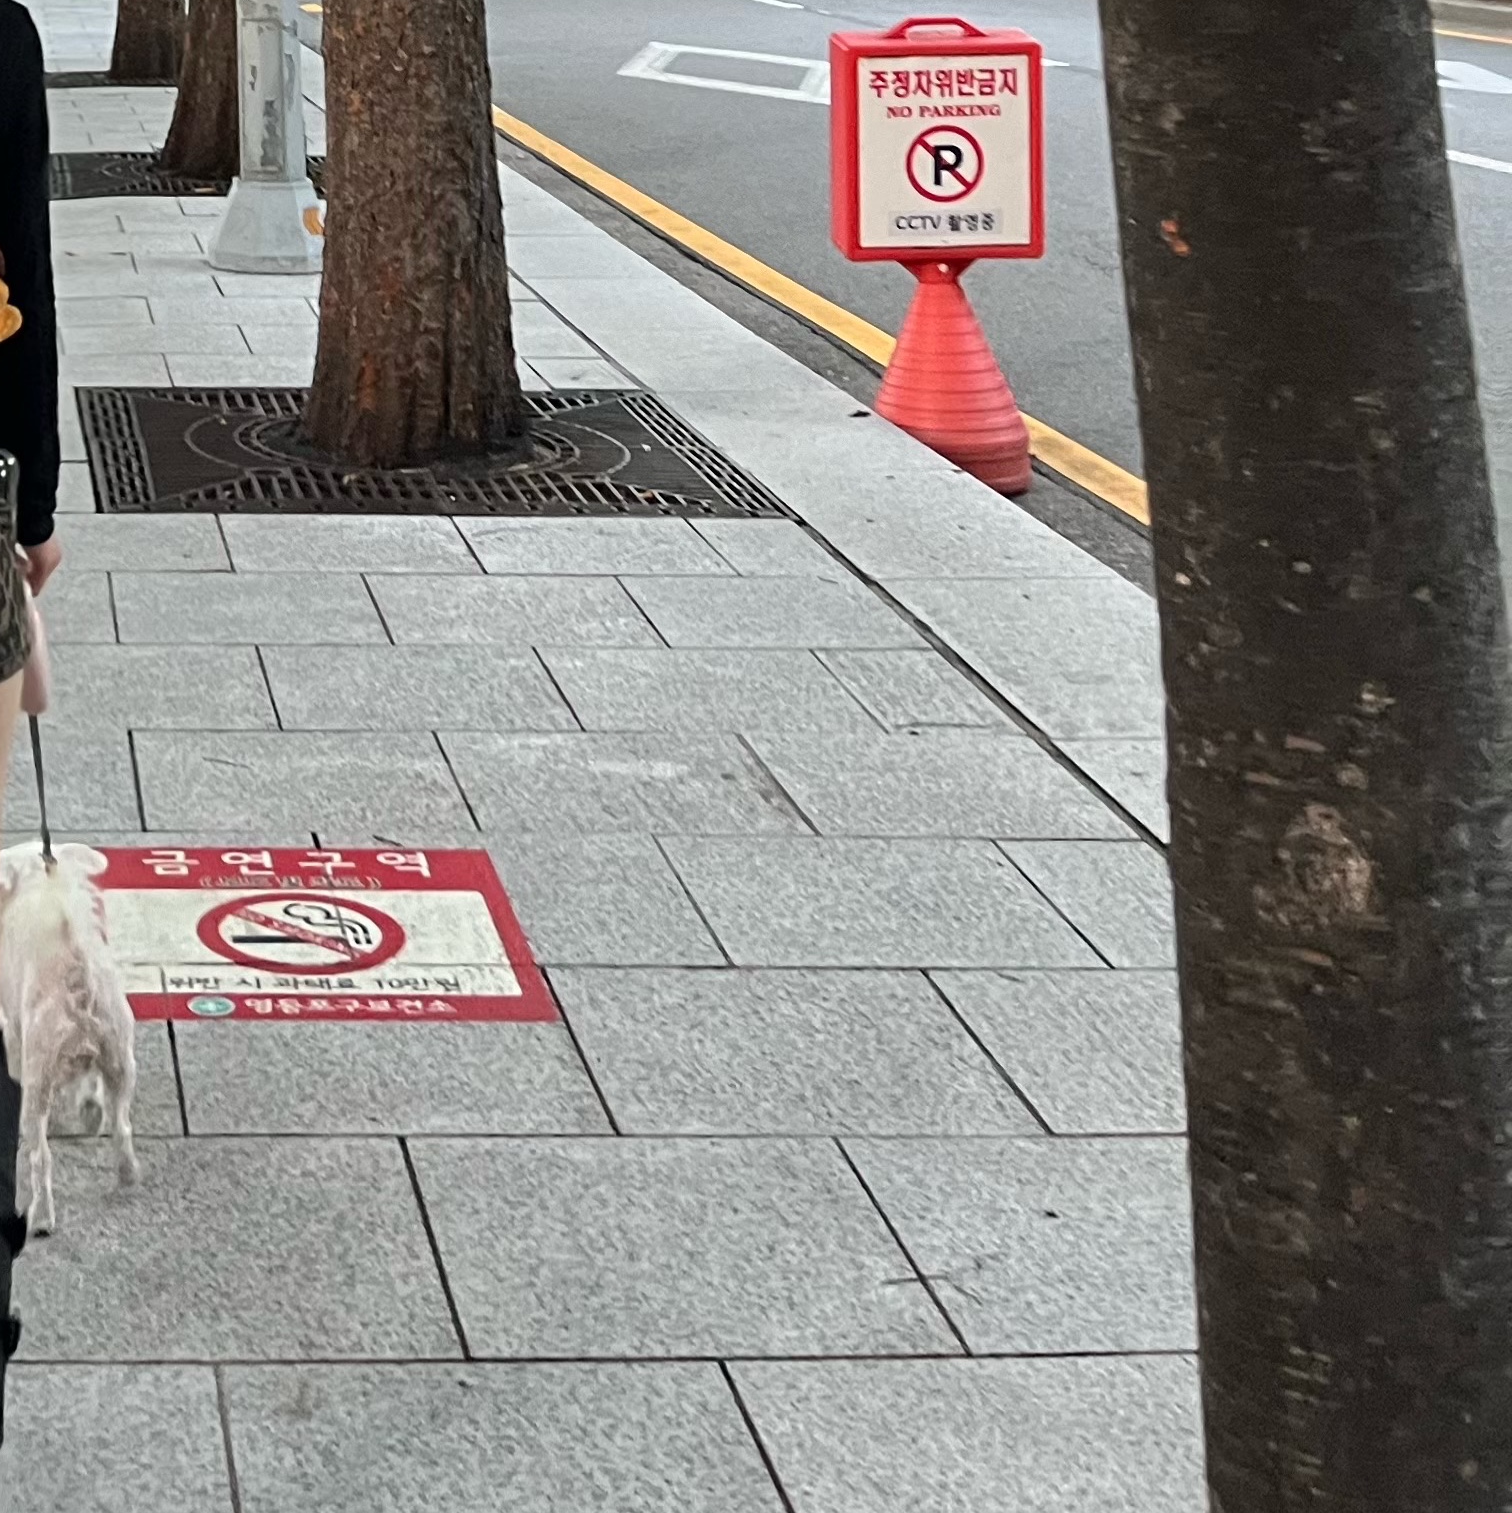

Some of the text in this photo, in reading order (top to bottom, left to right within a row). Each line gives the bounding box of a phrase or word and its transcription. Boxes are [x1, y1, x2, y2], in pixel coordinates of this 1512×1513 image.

[869, 68, 1018, 98] 주정차위반금지
[886, 103, 1001, 119] NO PARKING
[933, 144, 964, 186] P
[895, 214, 942, 230] CCTV
[237, 976, 261, 990] 시
